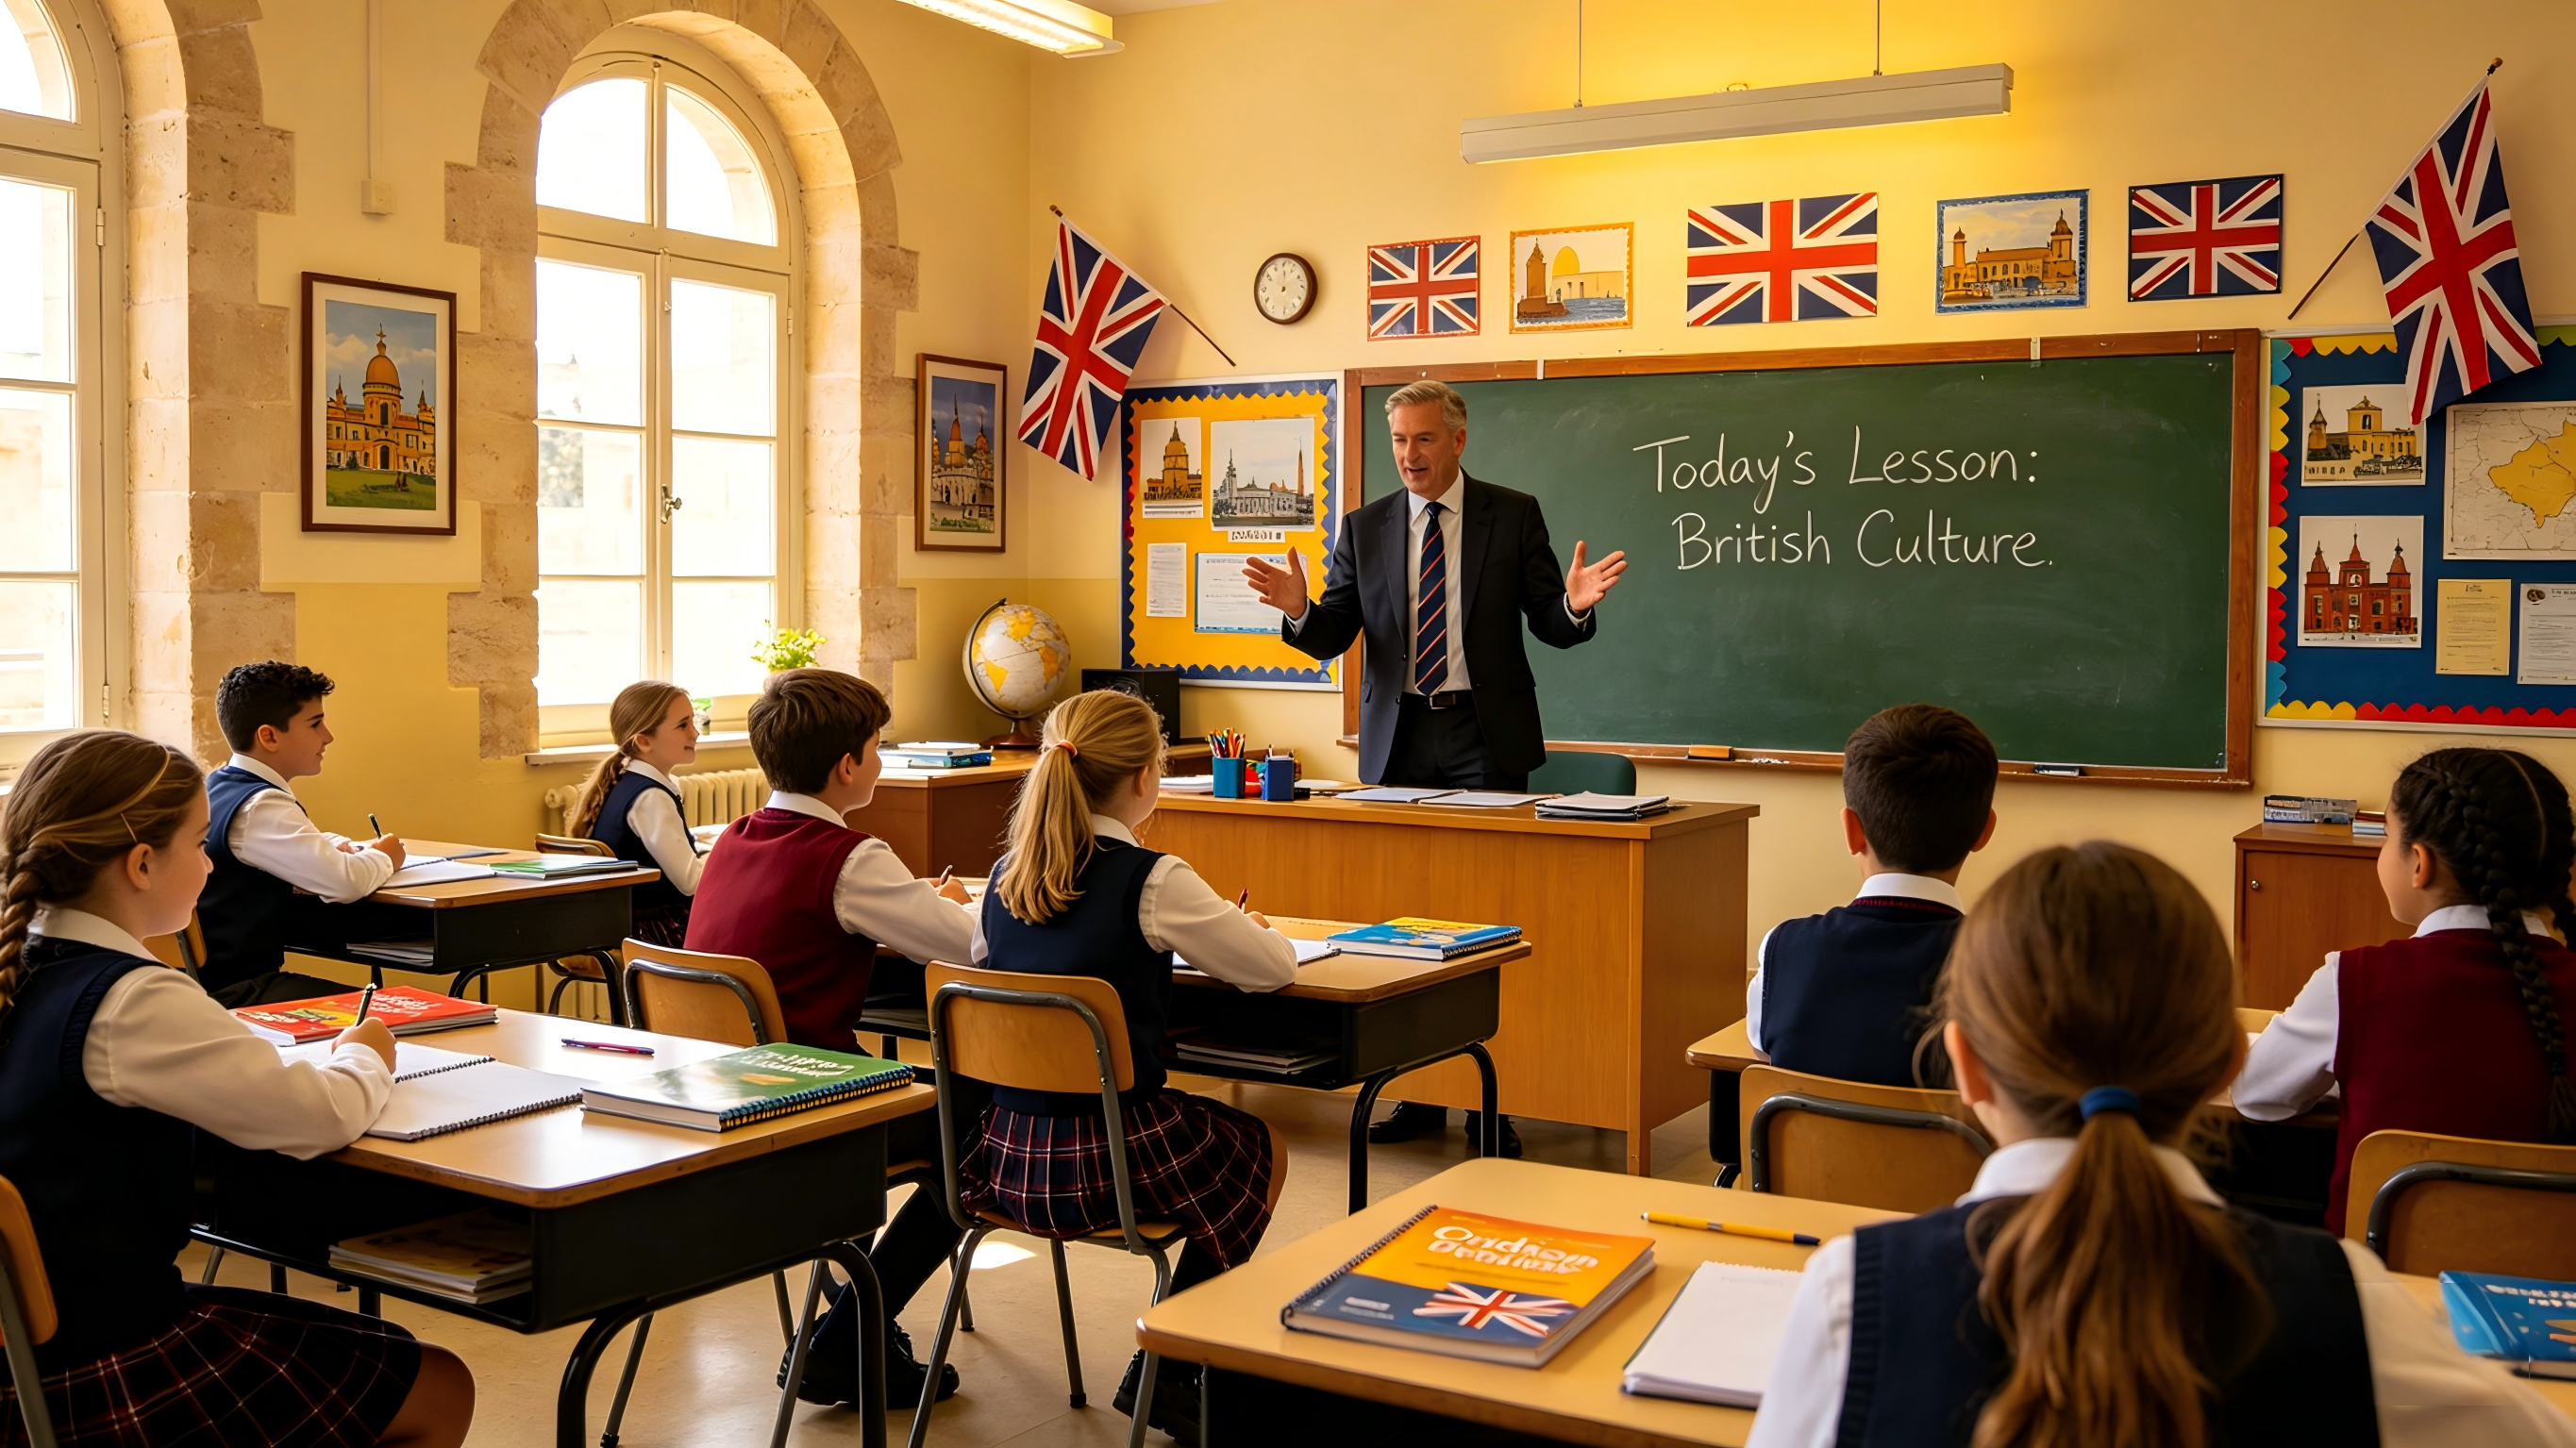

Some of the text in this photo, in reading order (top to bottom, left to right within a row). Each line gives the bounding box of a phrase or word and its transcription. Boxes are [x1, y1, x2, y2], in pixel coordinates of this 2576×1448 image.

[1632, 424, 2038, 514] Today's Lesson:
[1671, 508, 2053, 571] British Culture.
